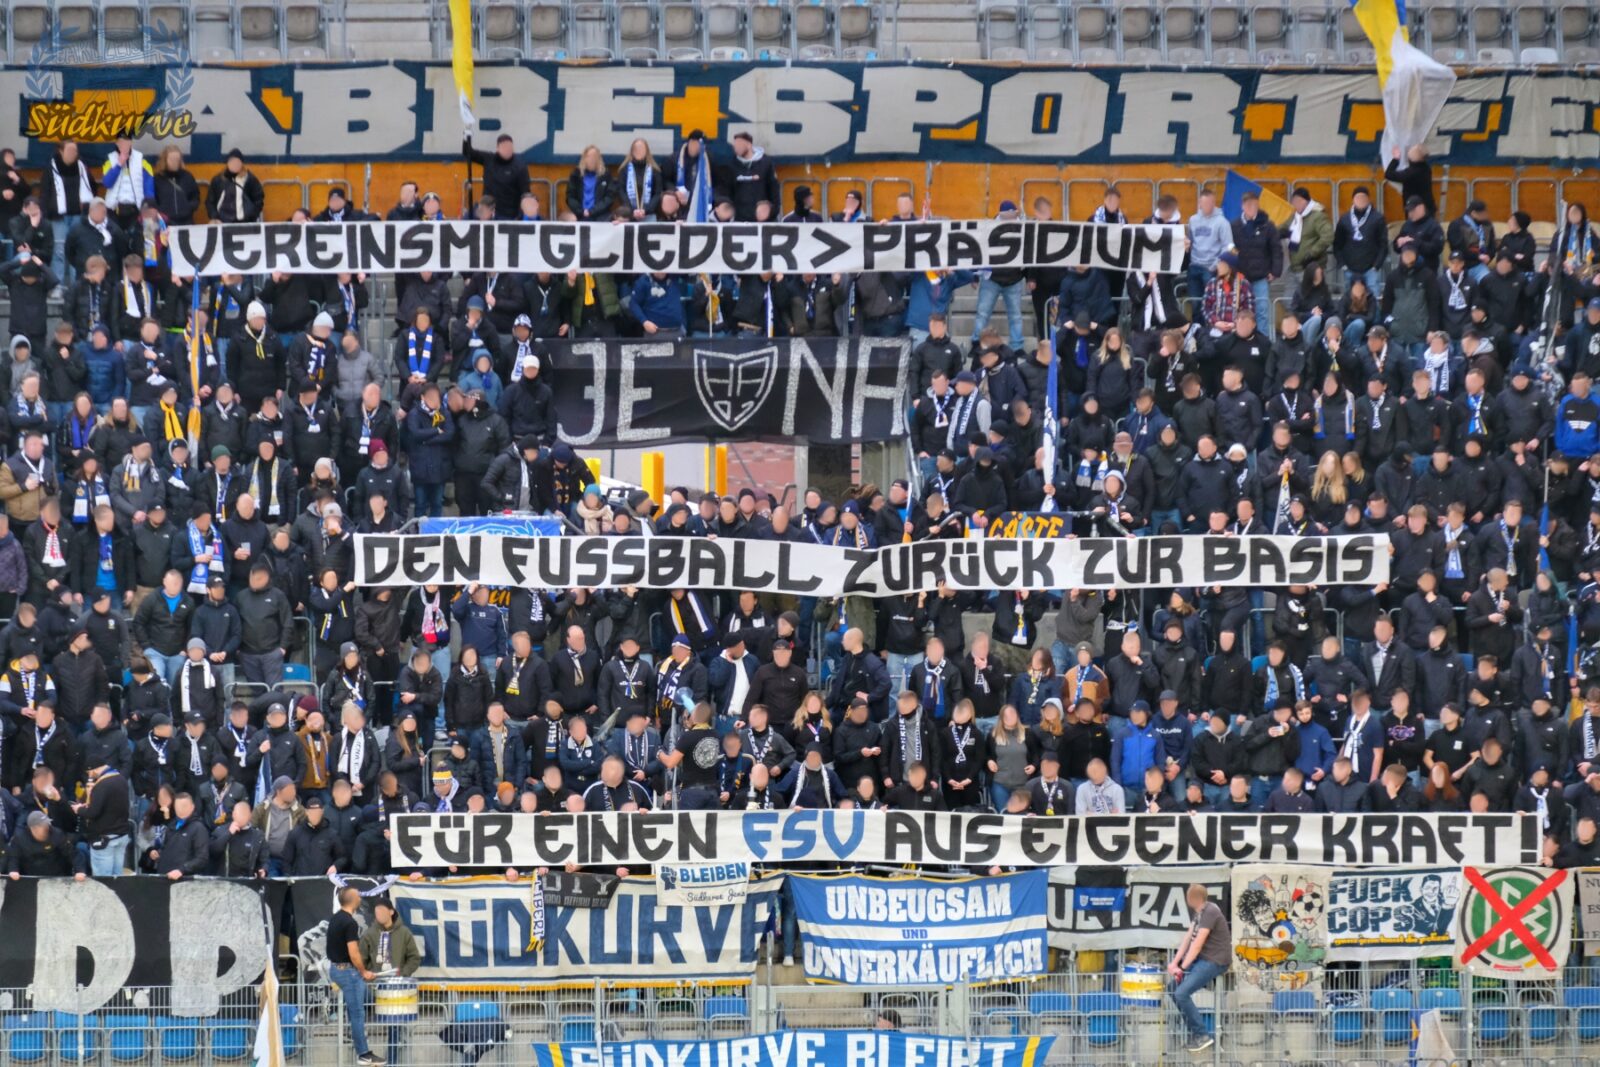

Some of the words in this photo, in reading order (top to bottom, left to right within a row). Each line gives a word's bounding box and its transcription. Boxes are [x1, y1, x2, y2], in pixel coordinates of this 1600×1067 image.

[178, 222, 799, 271] VEREINSMITGLIEDER
[863, 220, 1172, 271] PRÄSIDIUM
[362, 535, 482, 584] DEN
[502, 536, 823, 592] FUSSBALL
[843, 537, 1056, 594] ZURÜCK
[1081, 537, 1183, 586] ZUR
[1203, 534, 1374, 584] BASIS
[396, 813, 517, 864] FÜR
[534, 812, 718, 863] EINEN
[742, 810, 865, 860] FSV
[884, 811, 1001, 861] AUS
[1021, 814, 1301, 862] EIGENER
[1322, 814, 1538, 866] KRAFT!
[680, 862, 747, 882] BLEIBEN
[1328, 876, 1414, 905] FUCK
[826, 882, 1012, 923] UNBEUGSAM
[1327, 905, 1415, 934] COPS
[902, 928, 928, 940] UND
[803, 938, 1044, 985] UNVERKÄUFLICH
